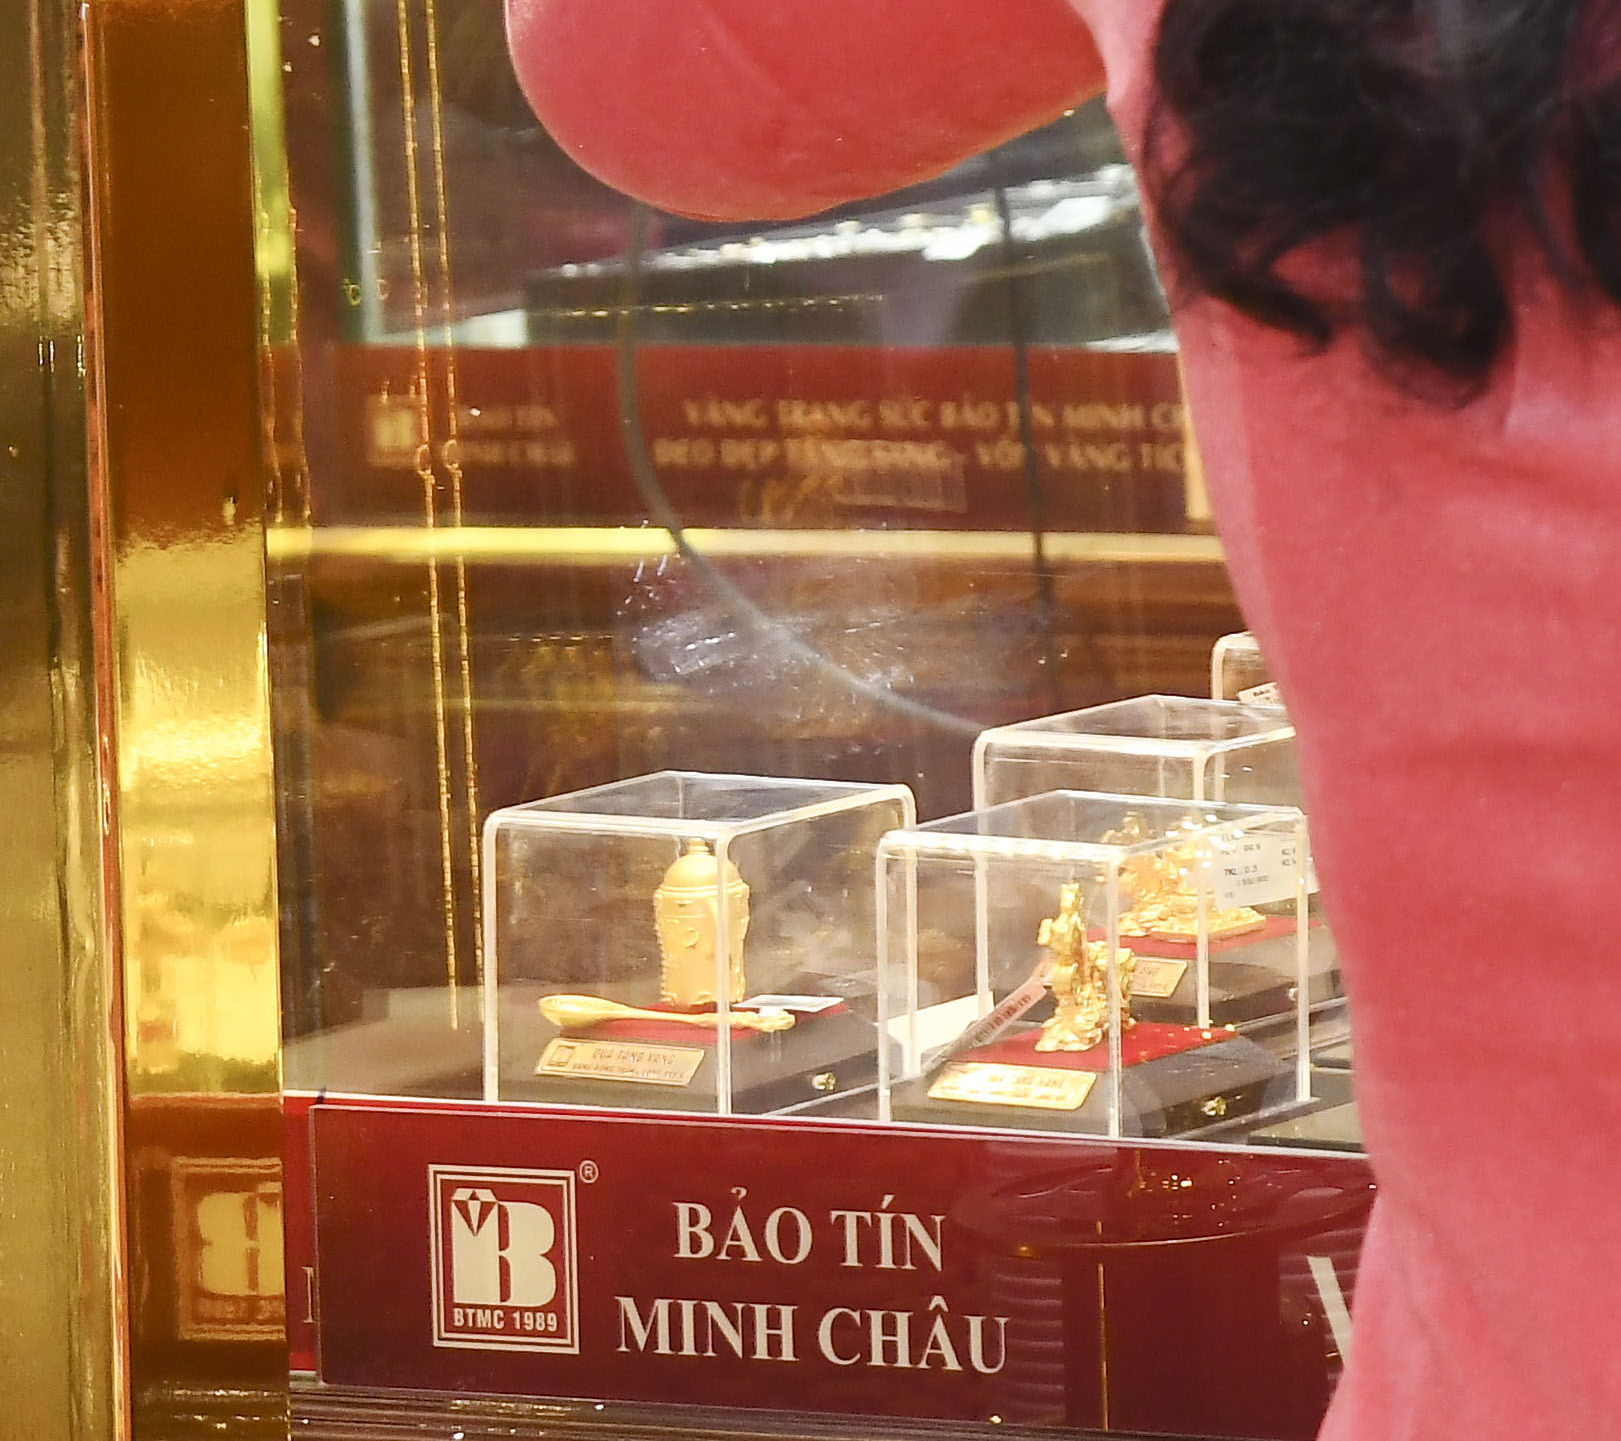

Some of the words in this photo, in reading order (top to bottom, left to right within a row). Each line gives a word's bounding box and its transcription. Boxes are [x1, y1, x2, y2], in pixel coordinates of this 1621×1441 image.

[674, 1186, 812, 1268] BẢO
[830, 1196, 943, 1271] TÍN
[453, 1309, 505, 1329] BTMC
[510, 1310, 560, 1332] 1989
[615, 1297, 800, 1364] MINH
[817, 1295, 1008, 1376] CHÂU
